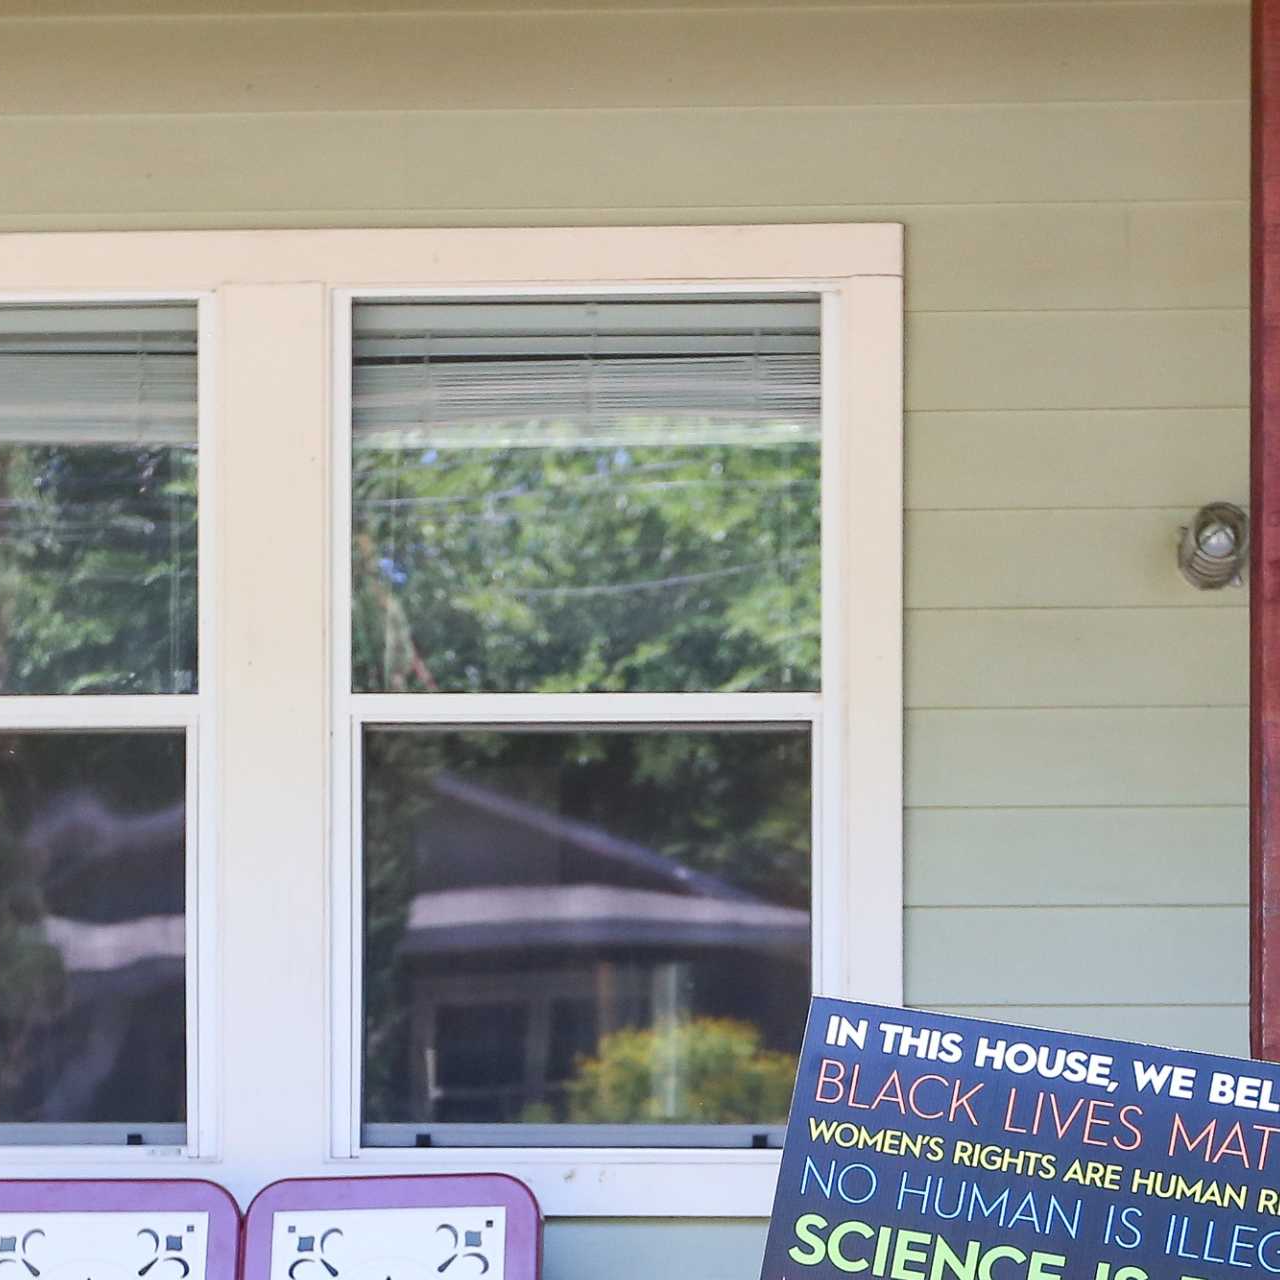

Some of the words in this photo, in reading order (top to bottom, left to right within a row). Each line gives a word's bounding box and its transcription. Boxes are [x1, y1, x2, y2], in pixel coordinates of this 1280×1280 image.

[826, 1016, 868, 1050] IN
[879, 1023, 962, 1063] THIS
[975, 1037, 1119, 1092] HOUSE,
[1133, 1061, 1196, 1099] WE
[816, 1059, 984, 1125] BLACK
[1004, 1088, 1144, 1150] LIVES
[801, 1156, 877, 1203] NO
[897, 1171, 1081, 1239] HUMAN
[1104, 1205, 1143, 1249] IS
[808, 1117, 944, 1161] WOMEN'S
[953, 1140, 1056, 1179] RIGHTS
[1063, 1158, 1123, 1190] ARE
[1131, 1169, 1248, 1210] HUMAN
